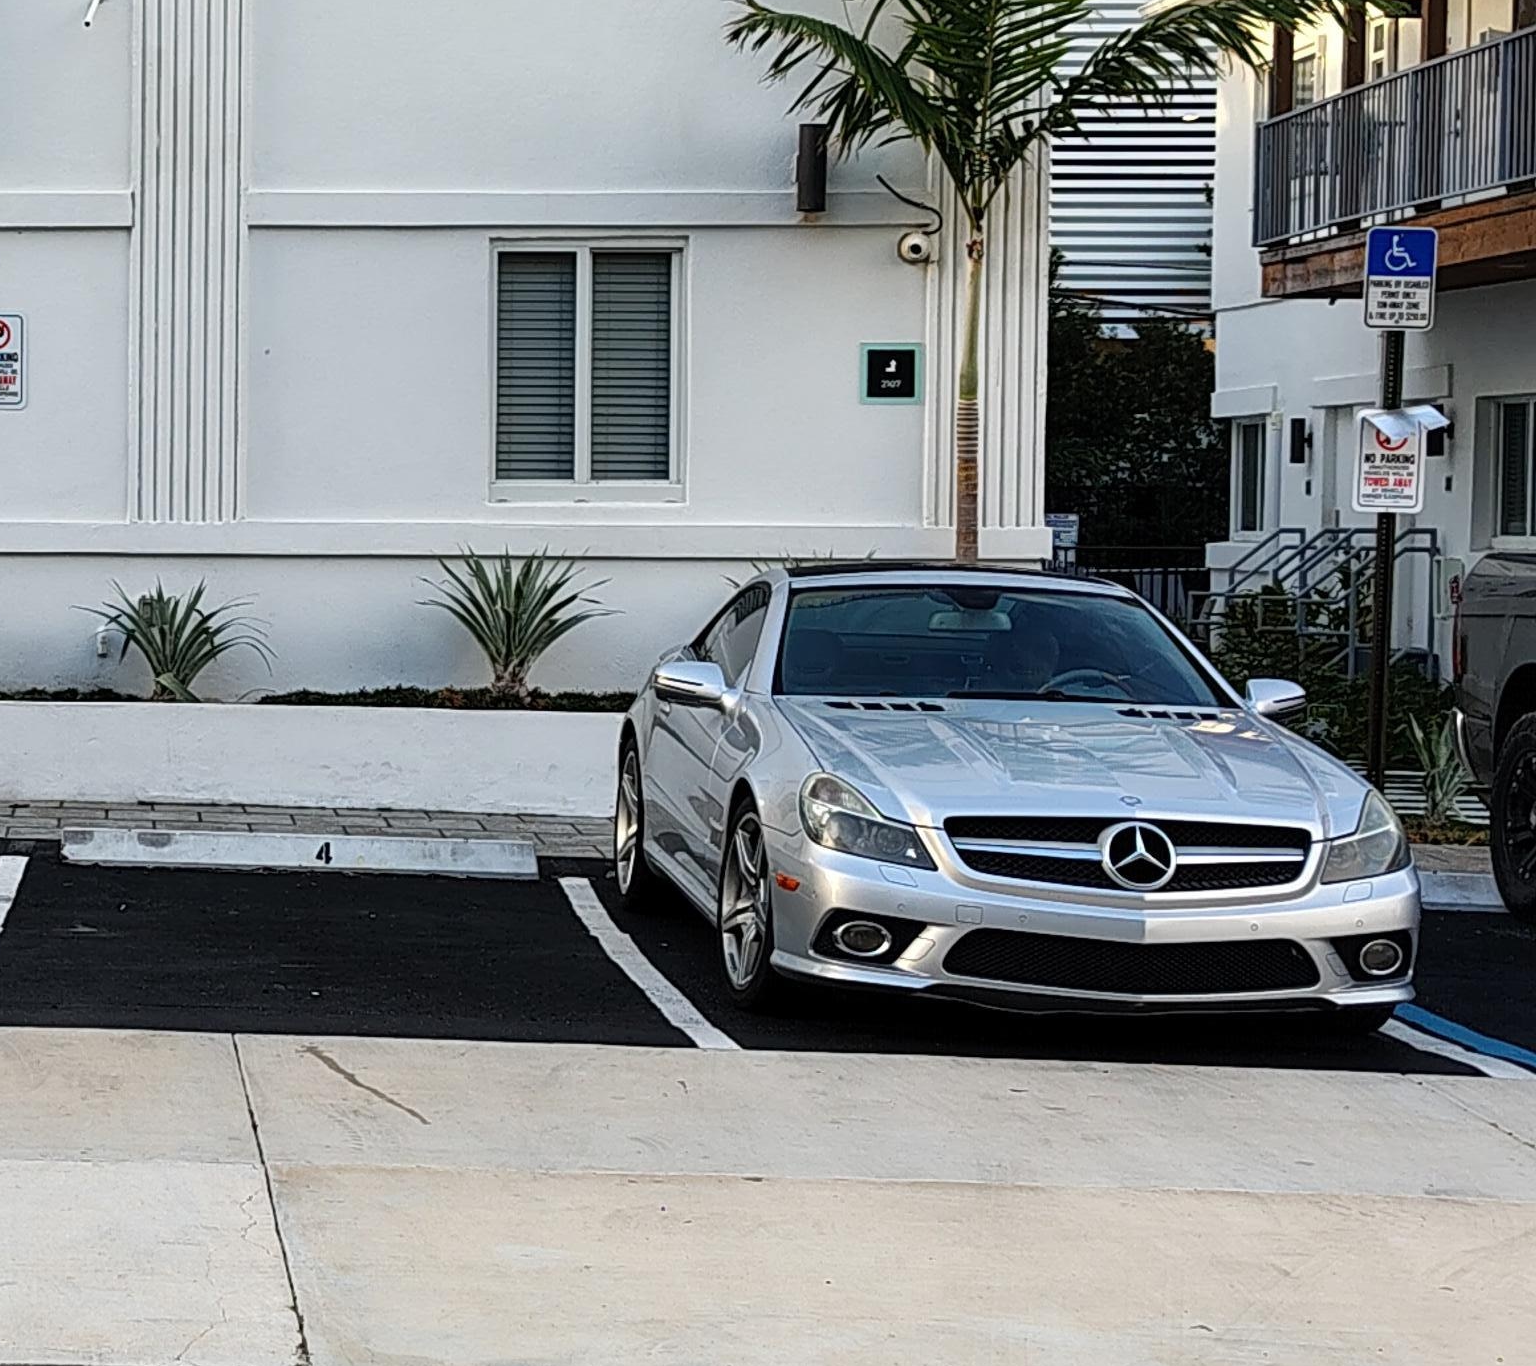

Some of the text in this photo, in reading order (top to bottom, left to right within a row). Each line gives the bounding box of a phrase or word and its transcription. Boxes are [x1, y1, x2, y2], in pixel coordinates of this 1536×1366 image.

[0, 375, 16, 385] AWAY
[1364, 453, 1415, 465] NO PARKING
[1364, 477, 1413, 488] TOWED AWAY
[315, 841, 333, 865] 4
